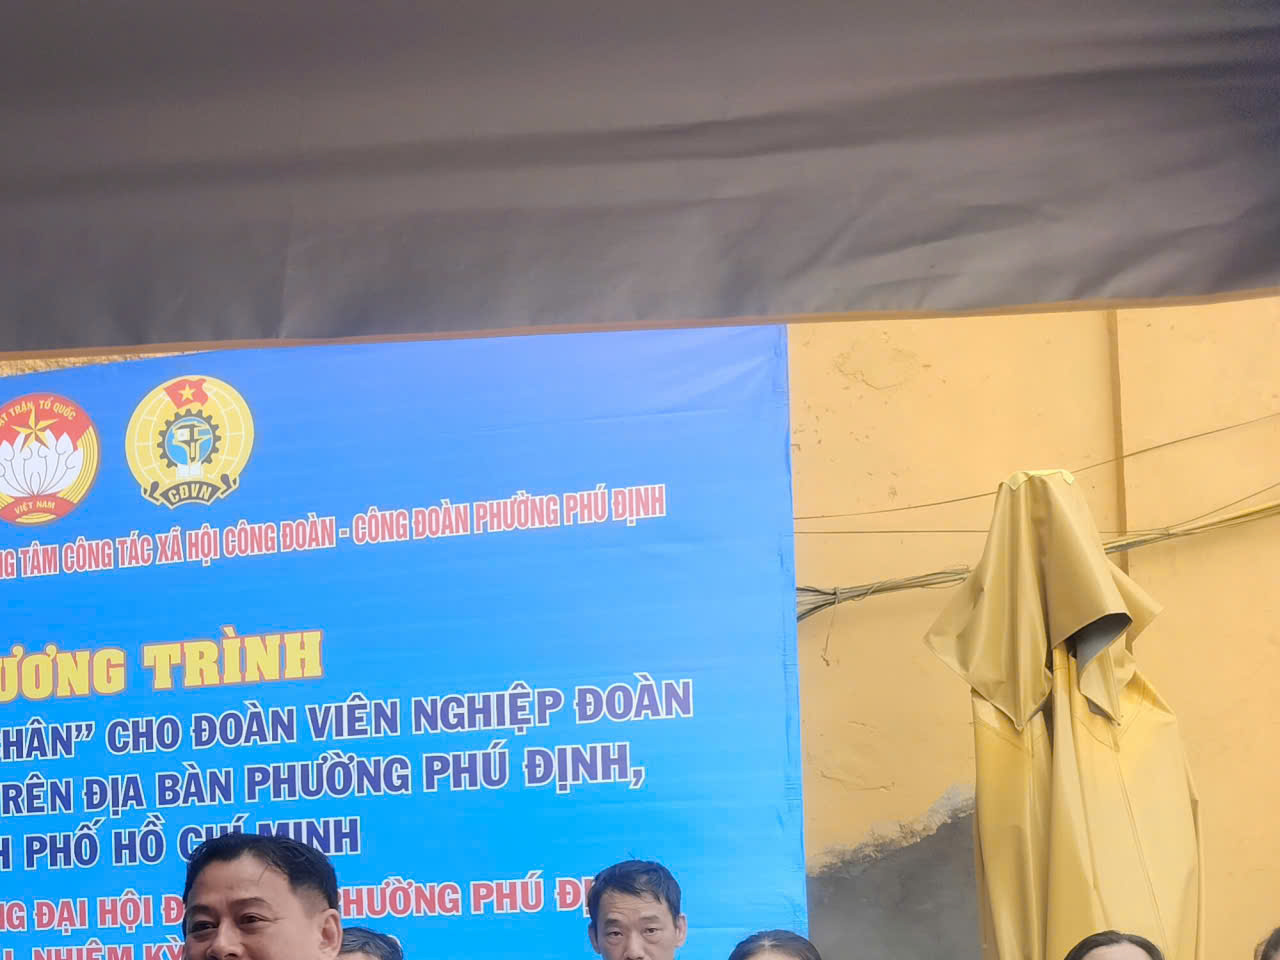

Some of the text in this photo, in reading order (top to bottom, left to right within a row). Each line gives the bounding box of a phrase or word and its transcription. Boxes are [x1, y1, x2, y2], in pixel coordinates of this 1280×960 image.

[168, 484, 212, 502] CĐVN
[19, 542, 59, 577] TÂM
[62, 537, 113, 573] CÔNG
[116, 531, 153, 568] TÁC
[156, 526, 183, 565] XÃ
[186, 524, 219, 567] HỘI
[223, 520, 276, 557] CÔNG
[280, 513, 336, 552] ĐOÀN
[353, 506, 409, 545] CÔNG
[412, 499, 470, 539] ĐOÀN
[473, 490, 560, 533] PHƯỜNG
[563, 483, 608, 525] PHÚ
[612, 484, 665, 526] ĐỊNH
[142, 625, 324, 691] TRÌNH
[106, 716, 182, 755] CHO
[190, 700, 297, 749] ĐOÀN
[306, 692, 400, 741] VIÊN
[412, 680, 564, 736] NGHIỆP
[574, 672, 693, 724] ĐOÀN
[83, 774, 146, 818] ĐỊA
[156, 762, 234, 807] BÀN
[244, 750, 412, 802] PHƯỜNG
[423, 739, 509, 793] PHÚ
[522, 741, 646, 794] ĐỊNH,
[24, 816, 105, 871] PHỐ
[113, 813, 166, 866] HỒ
[33, 899, 88, 936] ĐẠI
[97, 888, 153, 934] HỘI
[338, 876, 462, 919] HƯỜNG
[471, 870, 544, 914] PHÚ
